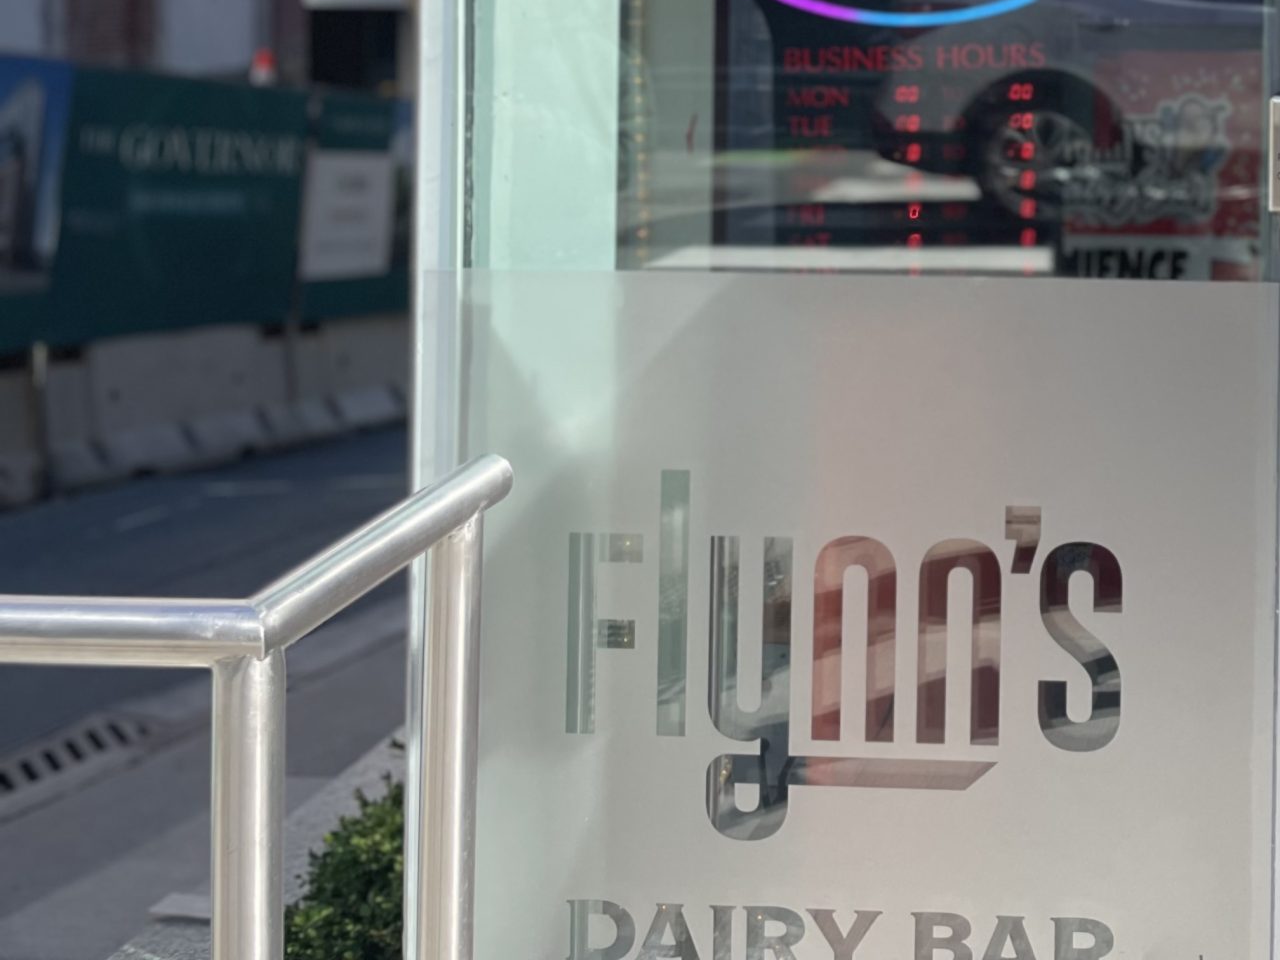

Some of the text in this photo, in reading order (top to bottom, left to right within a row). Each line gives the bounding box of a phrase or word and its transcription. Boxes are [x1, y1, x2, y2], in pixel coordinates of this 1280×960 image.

[783, 43, 1047, 74] BUSINESS HOURS
[566, 899, 884, 960] DAIRY
